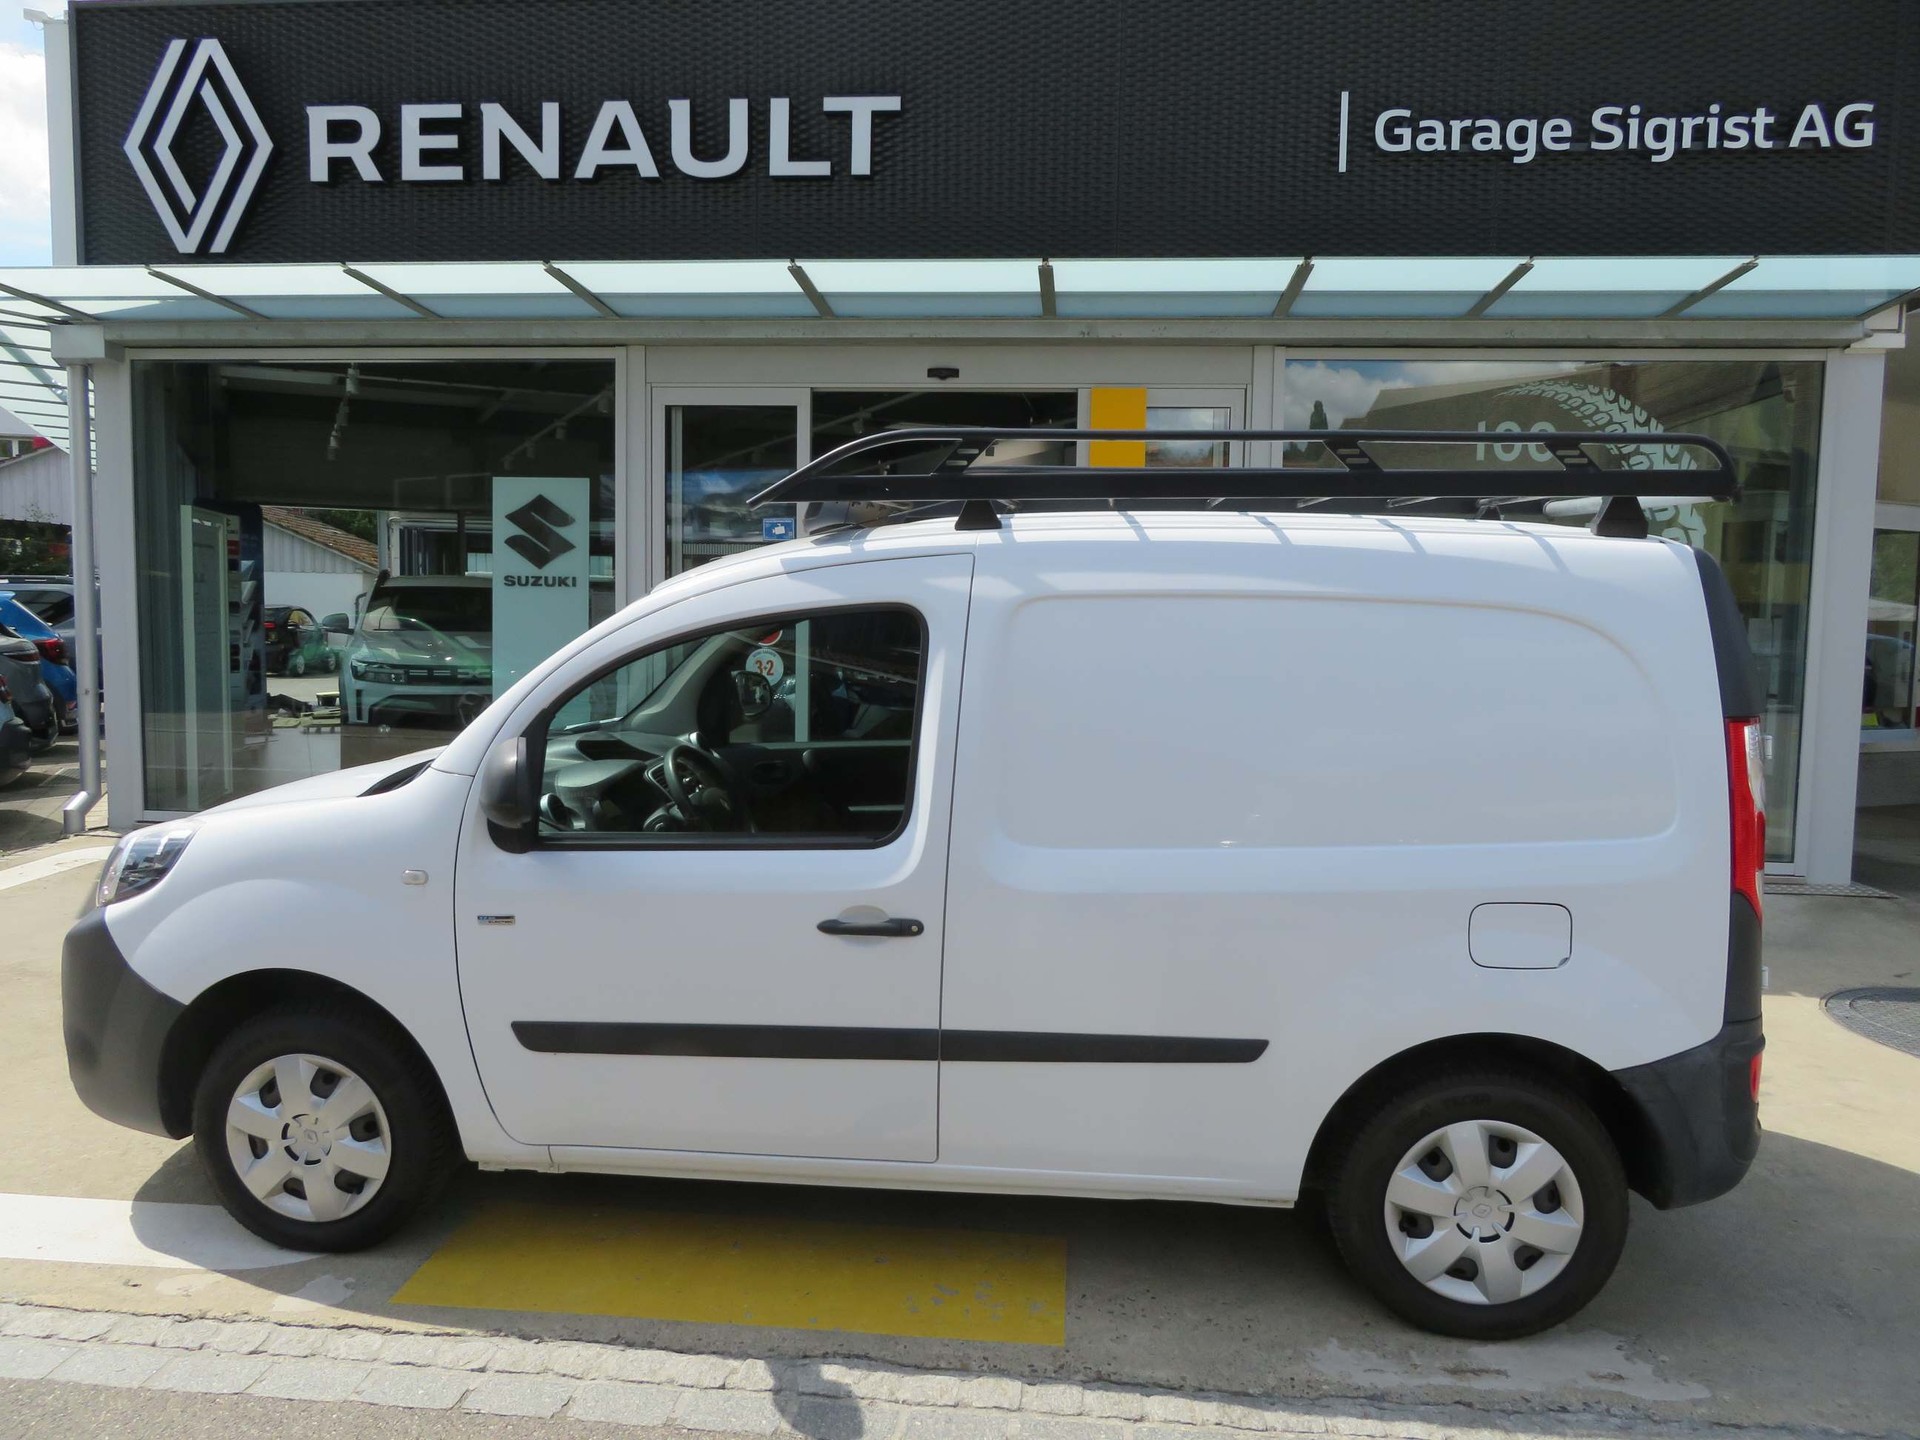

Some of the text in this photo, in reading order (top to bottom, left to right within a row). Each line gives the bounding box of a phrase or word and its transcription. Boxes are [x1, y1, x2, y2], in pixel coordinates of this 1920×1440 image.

[306, 95, 902, 183] RENAULT
[1374, 102, 1876, 164] Garage Sigrist AG
[503, 575, 577, 588] SUZUKI
